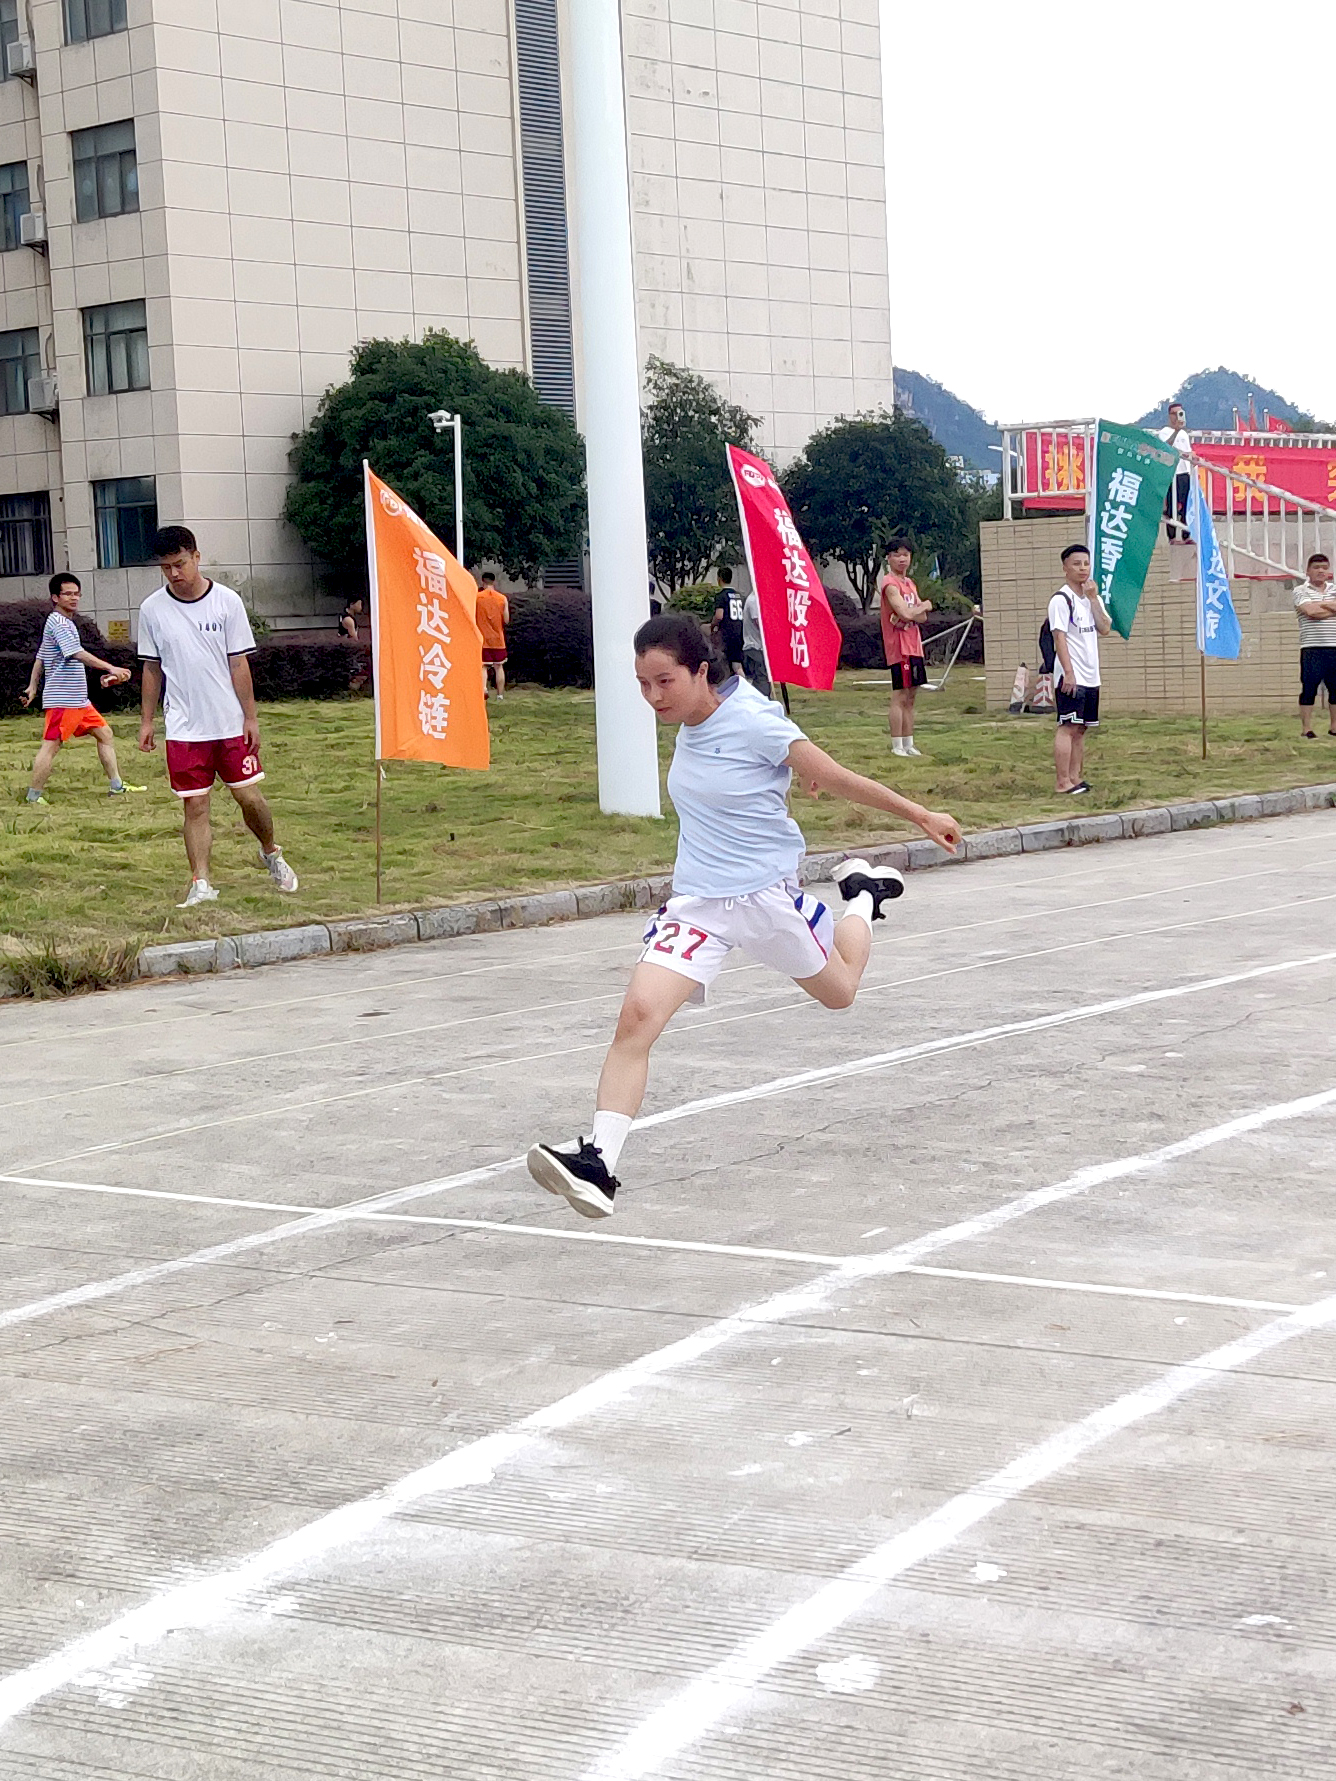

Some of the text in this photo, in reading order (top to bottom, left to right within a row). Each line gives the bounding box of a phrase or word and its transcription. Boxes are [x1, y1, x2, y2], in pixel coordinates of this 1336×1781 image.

[412, 547, 452, 740] 福达冷链
[773, 508, 812, 668] 福达股份
[653, 922, 708, 961] 27
